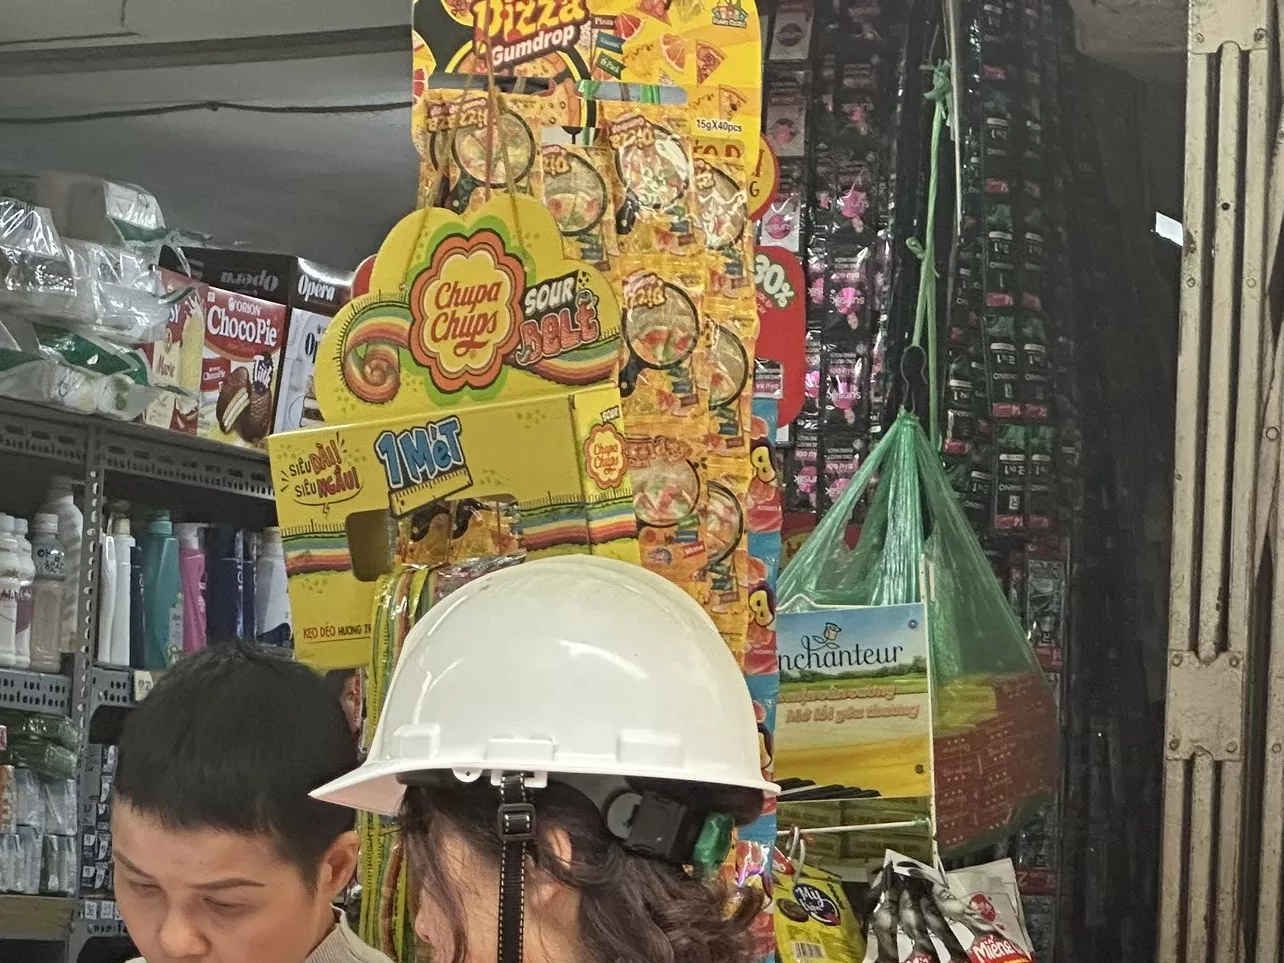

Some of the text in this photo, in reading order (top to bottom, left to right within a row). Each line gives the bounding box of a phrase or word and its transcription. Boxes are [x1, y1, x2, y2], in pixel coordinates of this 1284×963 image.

[490, 24, 576, 68] Gumdrop
[696, 118, 743, 133] 15gX40pcs
[435, 279, 503, 316] Chupa
[525, 278, 577, 315] SOUR
[754, 253, 795, 308] 30%
[206, 304, 278, 347] ChocoPie
[236, 303, 261, 316] ORION
[430, 309, 498, 345] Chups
[289, 458, 312, 477] SIÊU
[375, 428, 403, 486] 1
[294, 480, 318, 498] SIÊU
[778, 636, 903, 671] nchanteur
